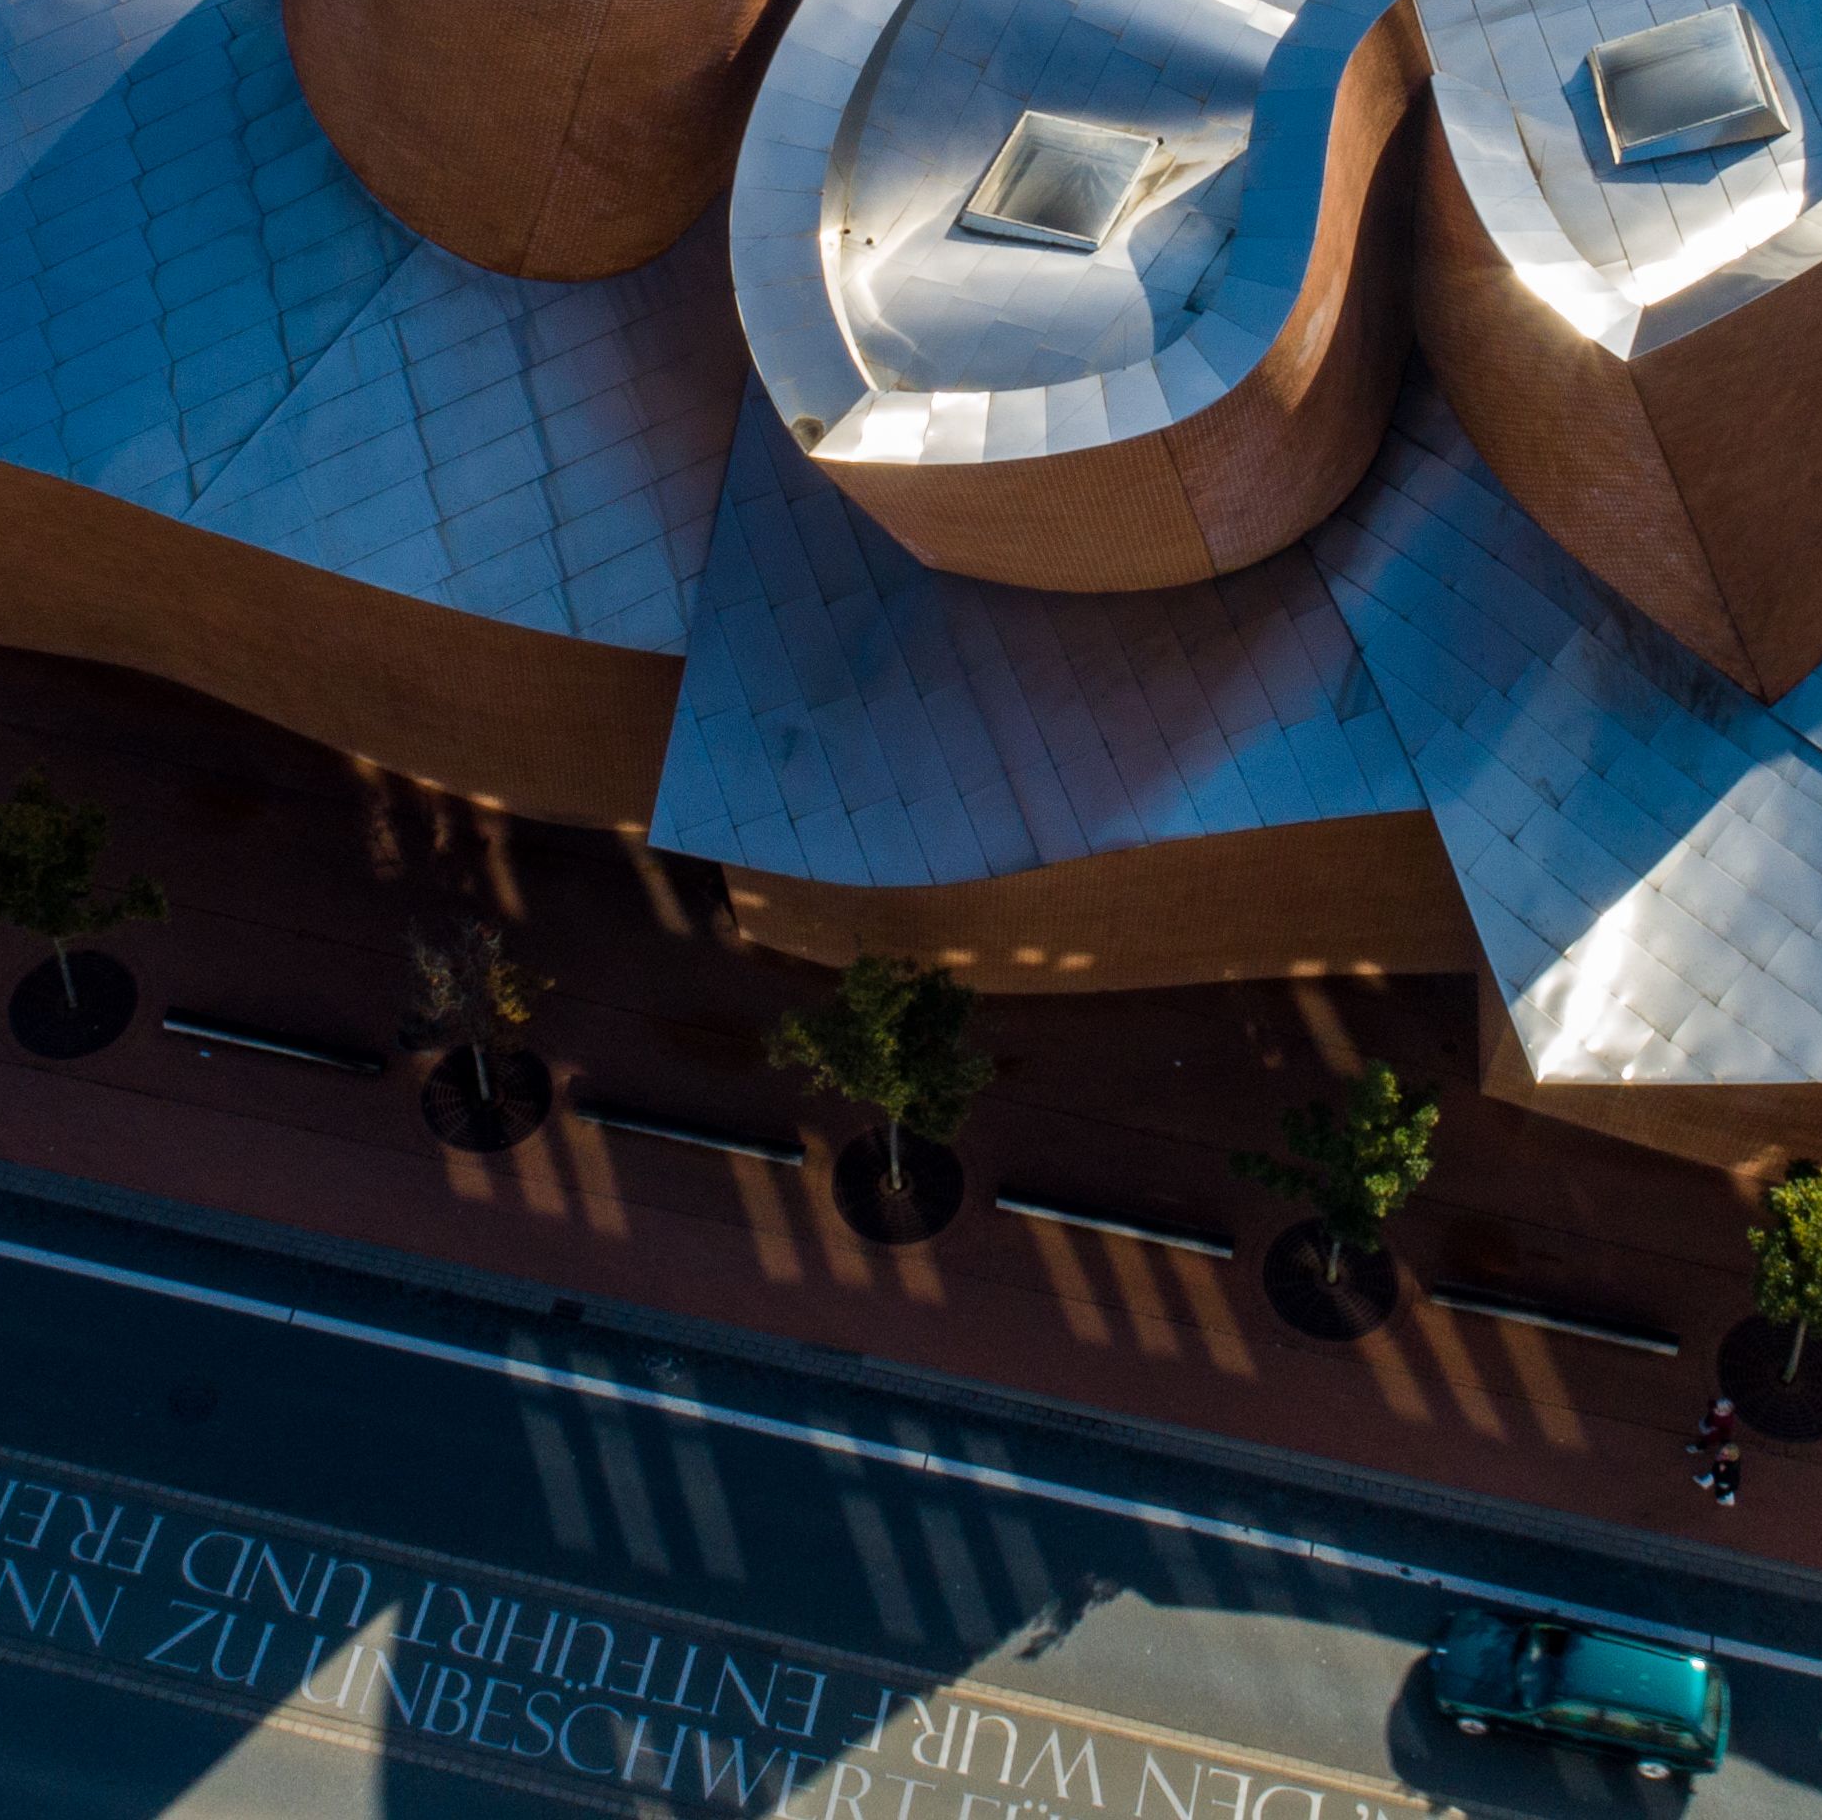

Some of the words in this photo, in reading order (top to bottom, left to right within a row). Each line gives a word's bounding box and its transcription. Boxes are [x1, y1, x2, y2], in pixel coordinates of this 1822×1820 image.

[182, 1531, 373, 1628] UND
[143, 1599, 277, 1688] ZU
[300, 1634, 936, 1820] UNBESCHWERT
[391, 1582, 828, 1737] ENTFÜHRT
[842, 1689, 1104, 1807] WURF
